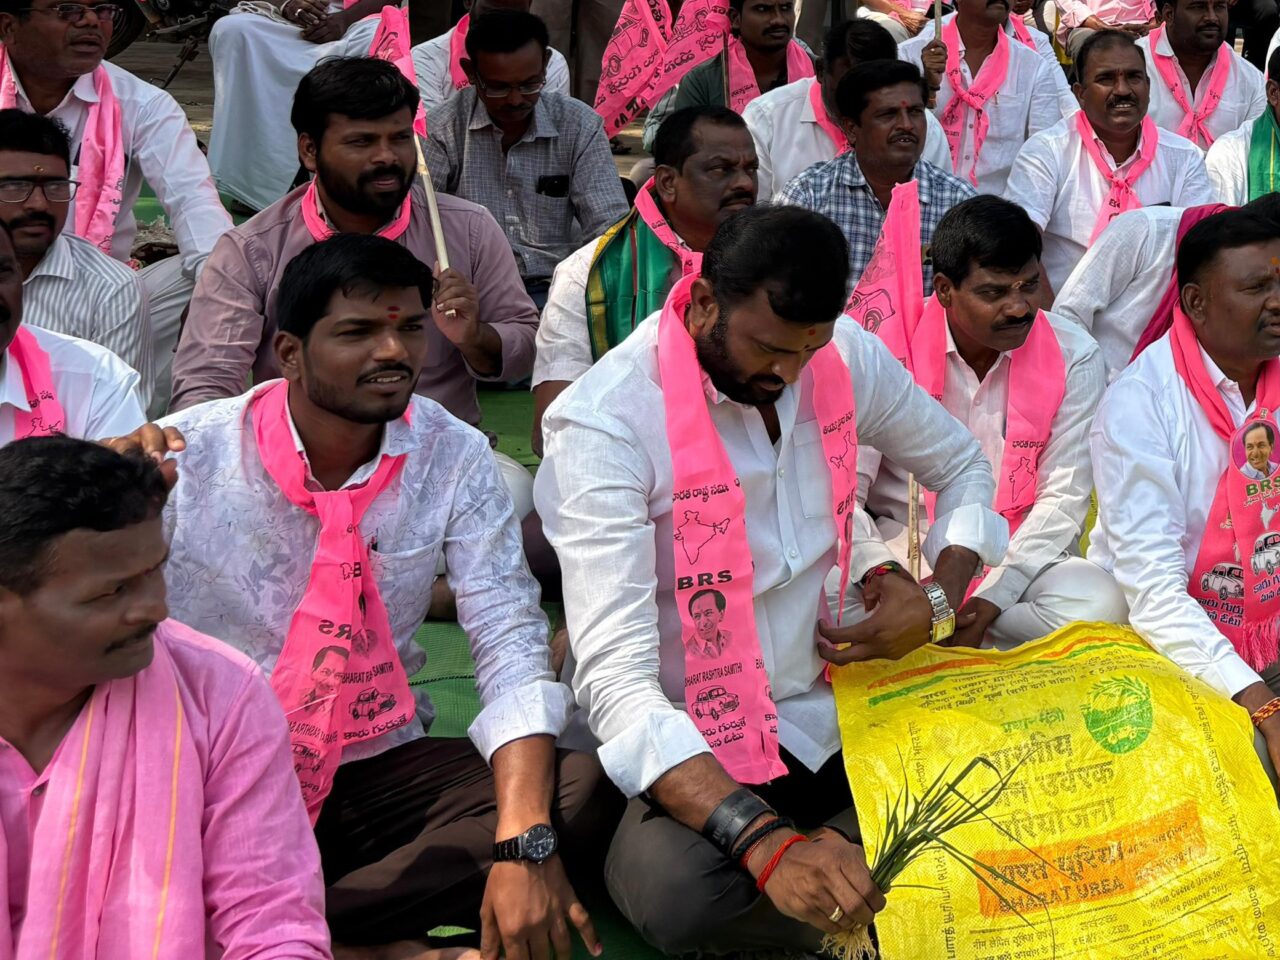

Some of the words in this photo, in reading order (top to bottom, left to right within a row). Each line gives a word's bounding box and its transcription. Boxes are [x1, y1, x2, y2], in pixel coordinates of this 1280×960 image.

[678, 570, 733, 590] BRS
[994, 795, 1117, 842] परियोजना
[999, 883, 1072, 912] BHARAT
[1076, 878, 1124, 900] UREA
